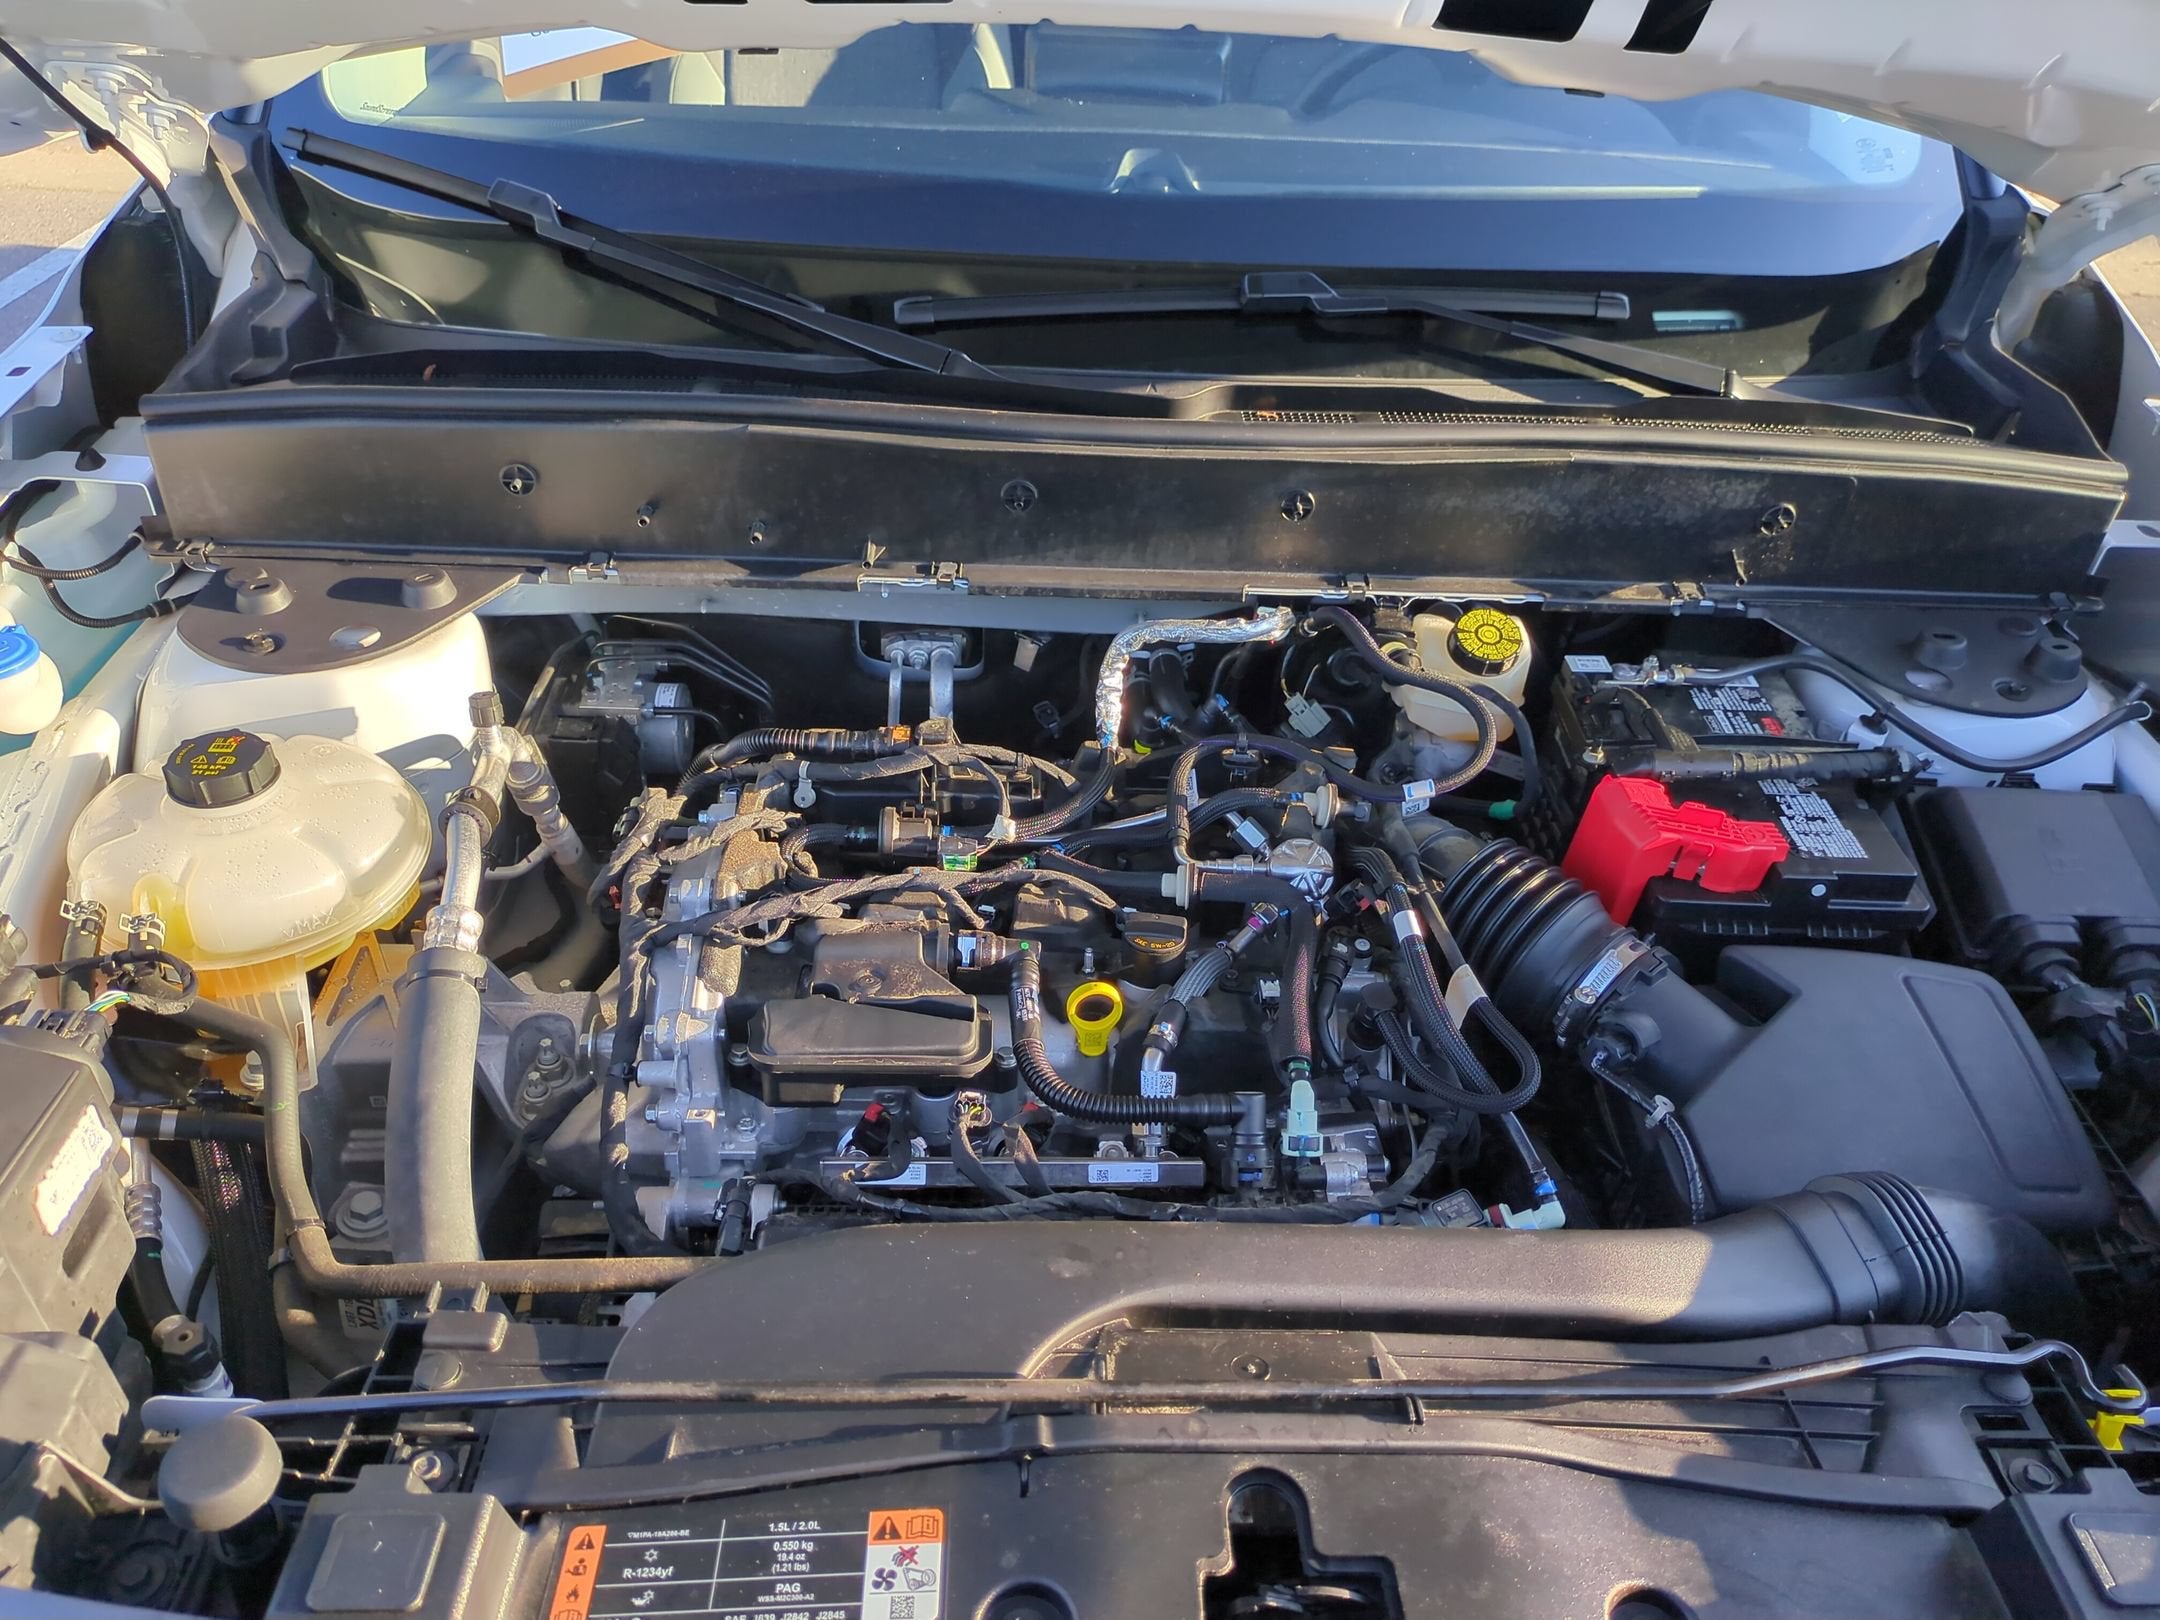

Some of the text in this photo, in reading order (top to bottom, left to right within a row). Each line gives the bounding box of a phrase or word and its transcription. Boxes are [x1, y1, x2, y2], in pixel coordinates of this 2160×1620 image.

[769, 1523, 790, 1532] 1.5L
[798, 1520, 821, 1530] 2.0L
[773, 1540, 814, 1552] 0.550 kg
[777, 1553, 806, 1561] 19.4 oz
[623, 1566, 674, 1579] R-1234yf
[771, 1562, 810, 1574] (1.21 lbs)
[775, 1582, 801, 1593] PAG
[815, 1610, 846, 1620] J2845
